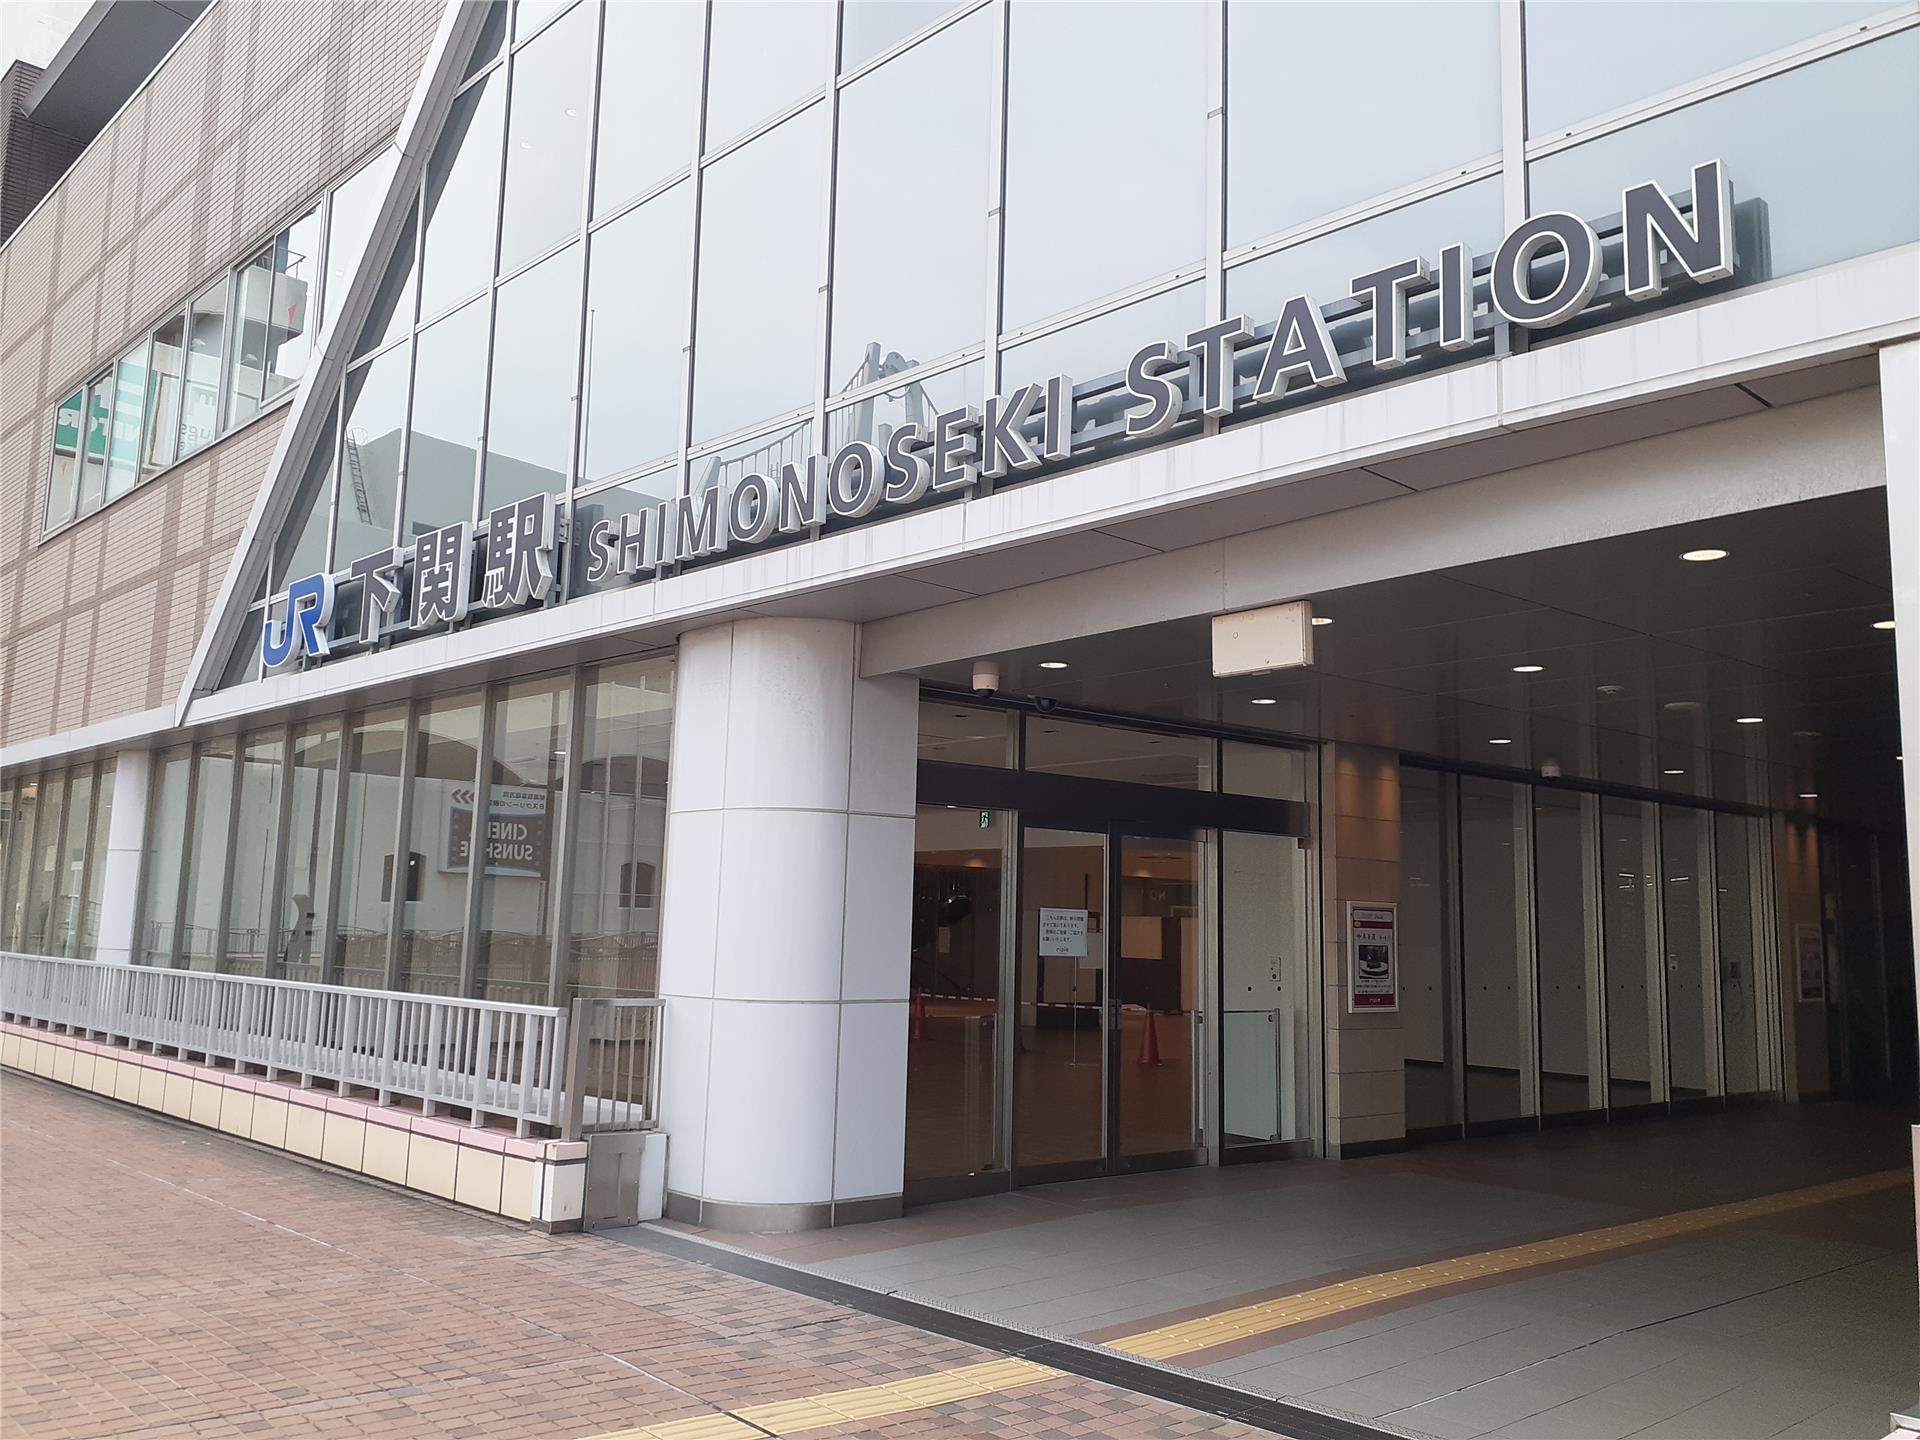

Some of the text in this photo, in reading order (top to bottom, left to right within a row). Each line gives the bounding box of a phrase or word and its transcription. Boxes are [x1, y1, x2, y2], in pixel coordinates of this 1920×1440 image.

[263, 158, 1735, 667] JR 下関駅 SHIMONOSEKI STATION
